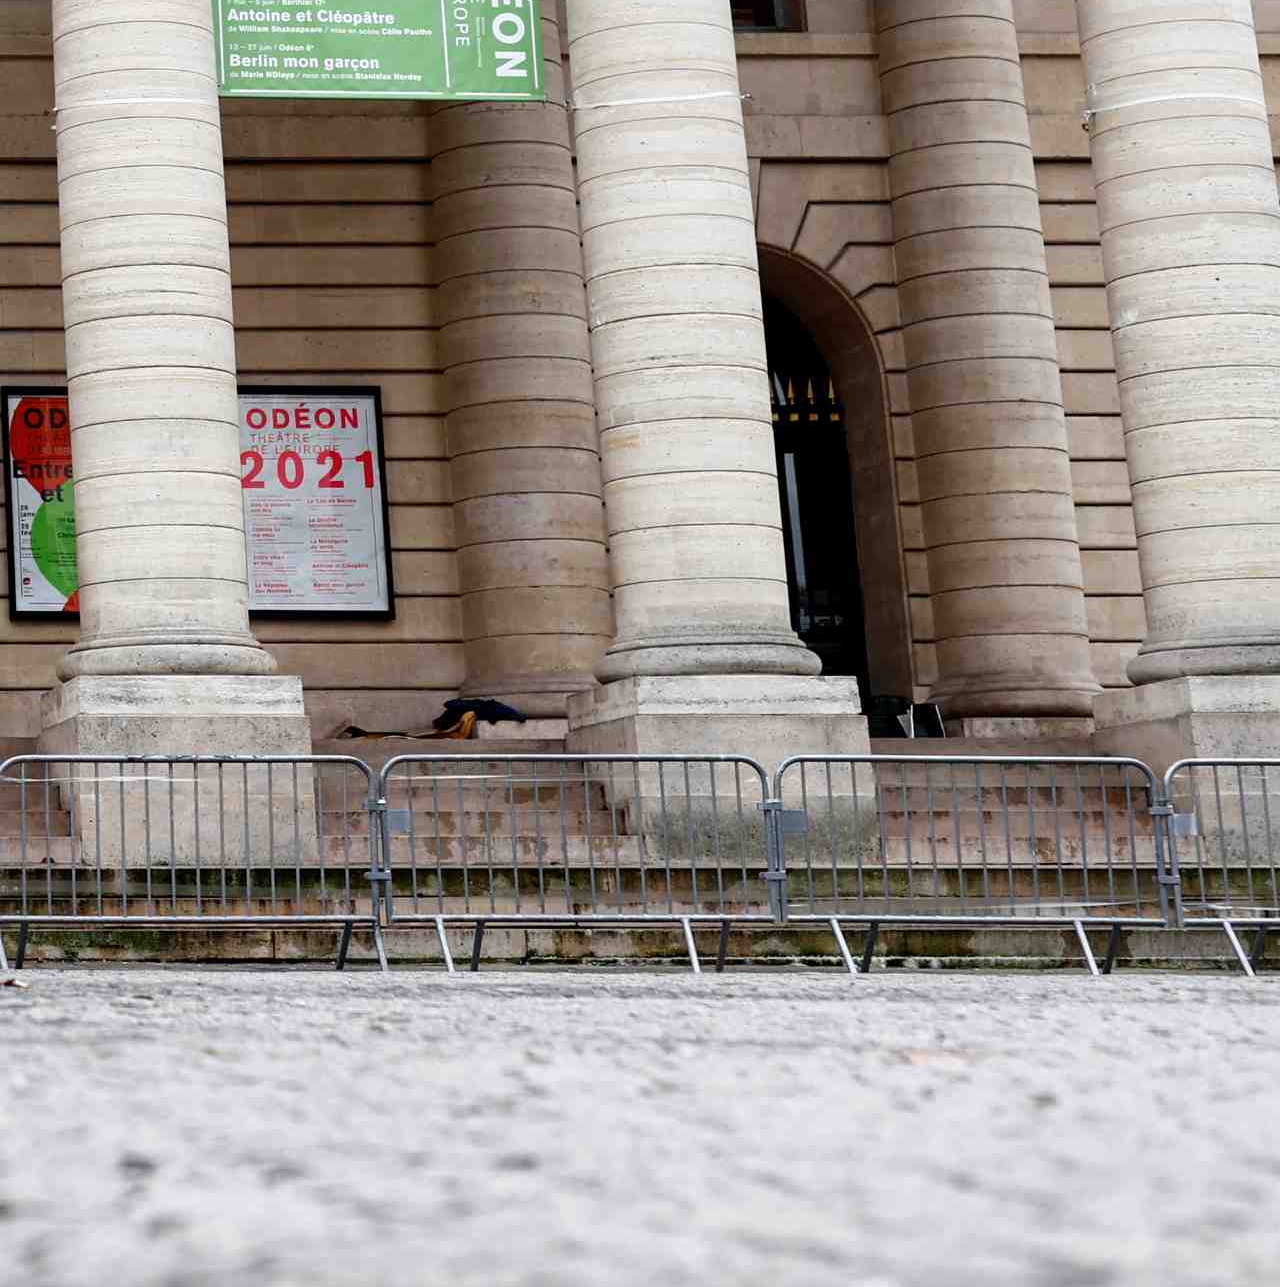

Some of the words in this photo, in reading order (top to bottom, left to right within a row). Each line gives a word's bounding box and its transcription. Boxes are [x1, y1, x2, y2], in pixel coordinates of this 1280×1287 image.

[228, 9, 290, 21] Antoine
[296, 10, 312, 21] et
[317, 10, 394, 25] Cléopâtre
[230, 54, 277, 67] Berlin
[284, 56, 318, 67] mon
[324, 57, 379, 71] garçon
[246, 403, 359, 428] ODÉON
[240, 450, 374, 489] 2021
[41, 488, 64, 502] et
